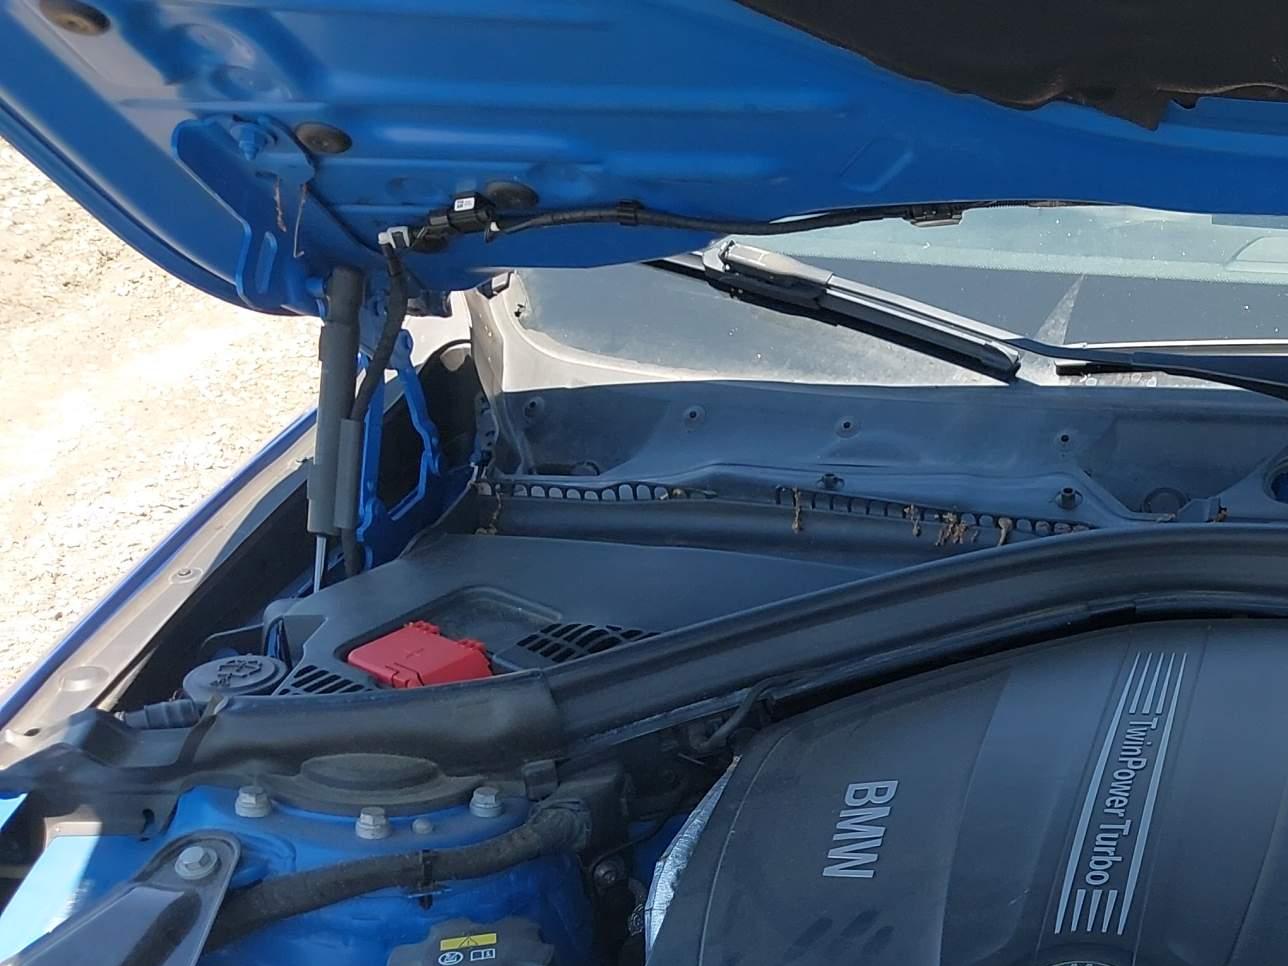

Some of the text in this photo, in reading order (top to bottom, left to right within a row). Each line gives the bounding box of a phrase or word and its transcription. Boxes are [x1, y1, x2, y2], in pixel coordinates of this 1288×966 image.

[822, 780, 899, 878] BMW
[1085, 716, 1159, 887] TwinPower Turbo
